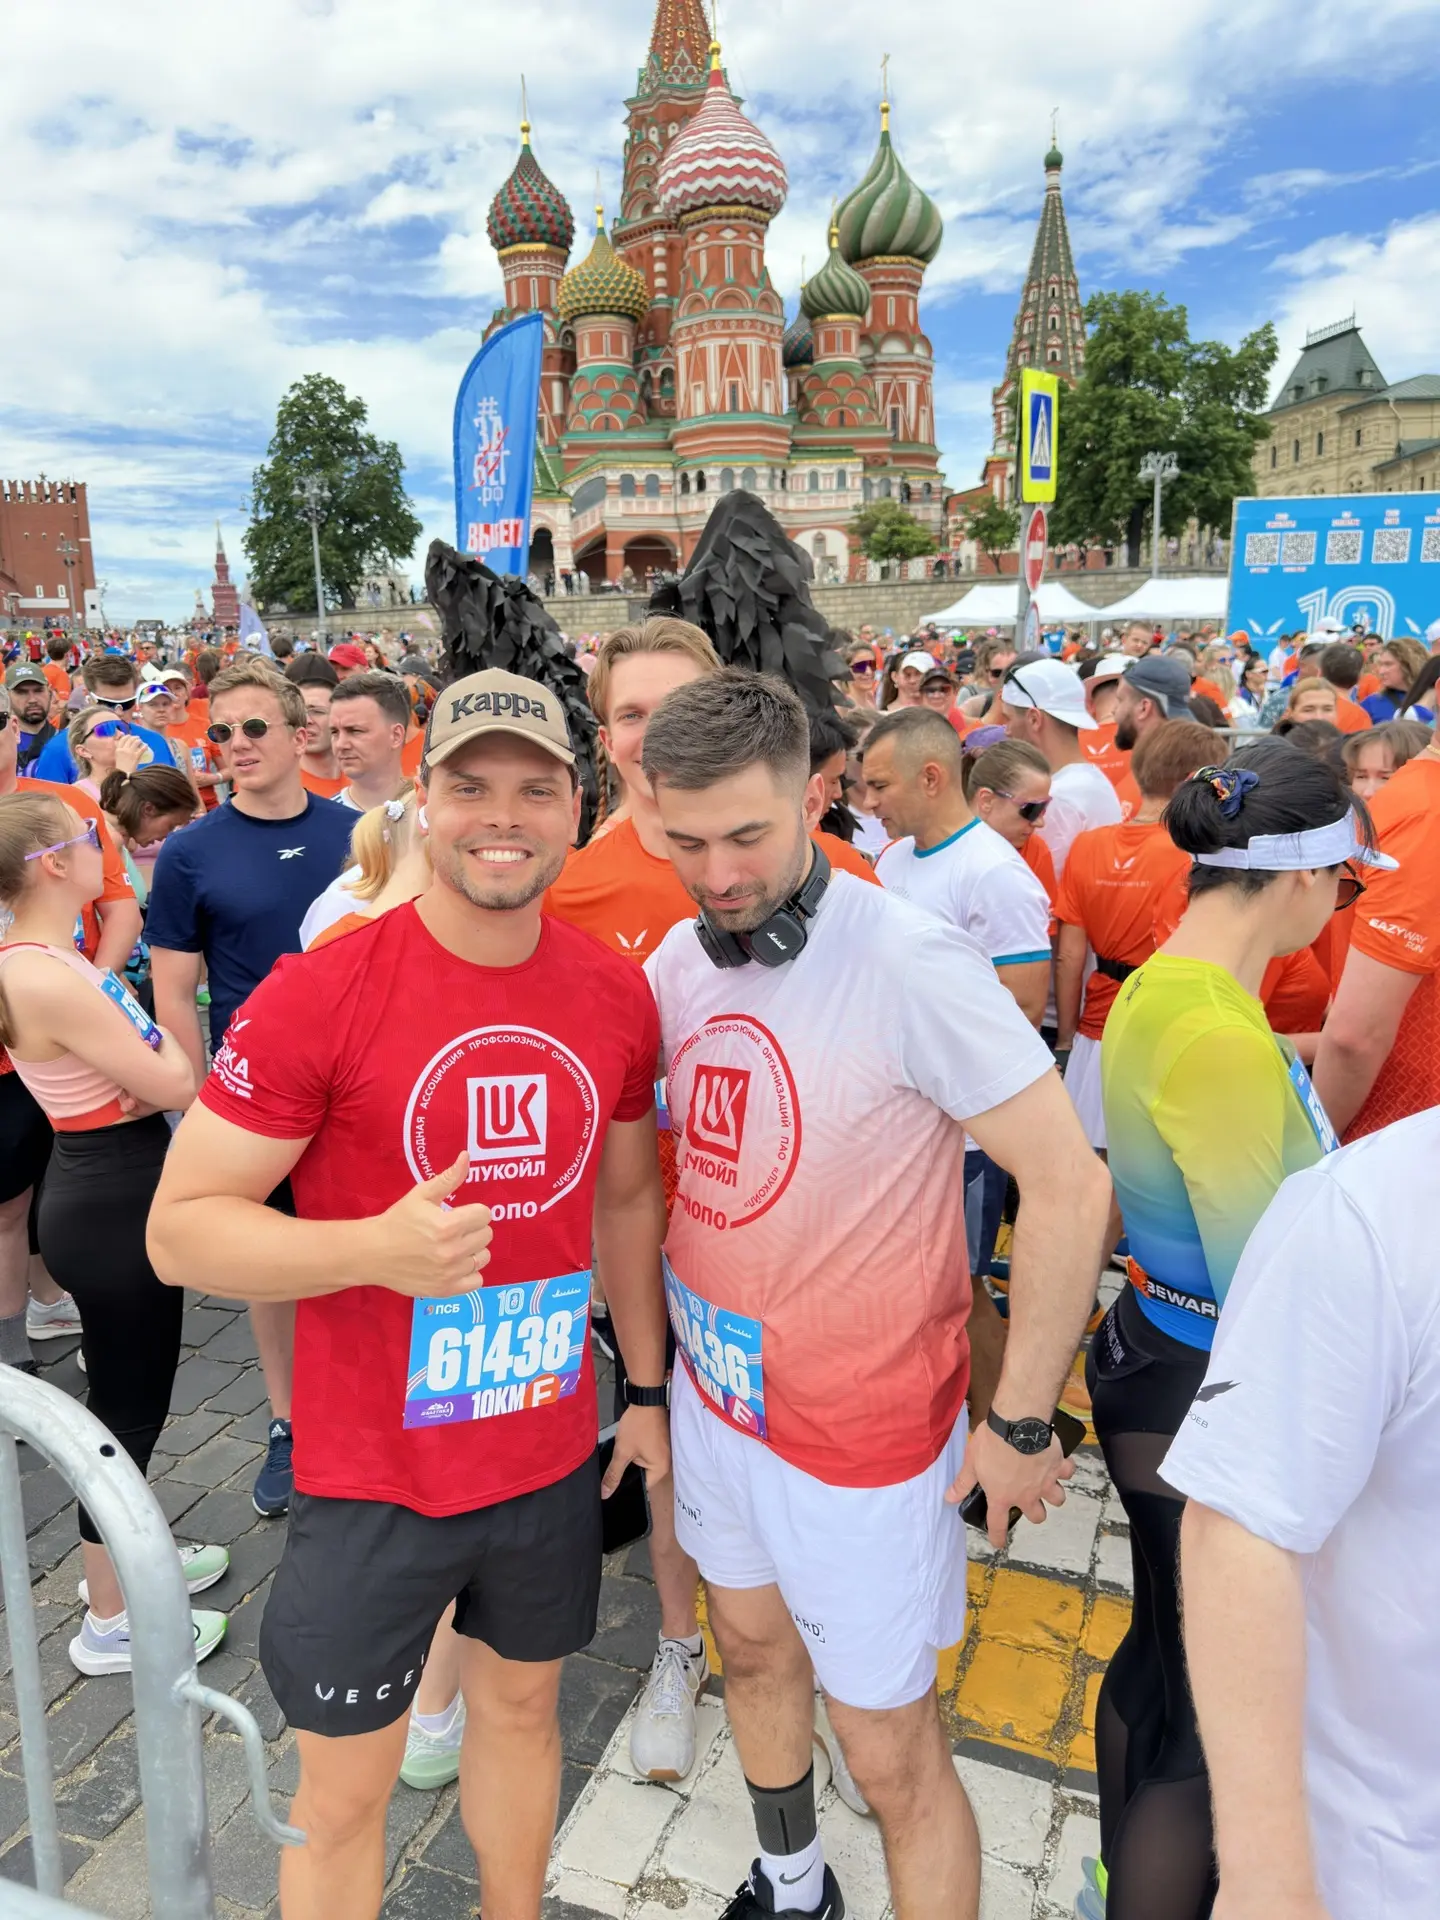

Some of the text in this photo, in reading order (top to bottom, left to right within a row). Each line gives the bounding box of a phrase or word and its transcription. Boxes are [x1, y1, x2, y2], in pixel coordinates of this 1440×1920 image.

[1296, 585, 1396, 643] 10
[451, 692, 548, 723] Kappa
[468, 1035, 547, 1052] ПРОФСОЮЗНЫХ
[420, 1048, 466, 1110] АССОЦИАЦИЯ
[551, 1050, 593, 1111] ОРГАНИЗАЦИЙ
[761, 1047, 792, 1128] ОРГАНИЗАЦИЙ
[778, 1136, 789, 1161] ПАО
[582, 1117, 592, 1139] ПАО
[465, 1158, 546, 1184] ЛУКОЙЛ
[552, 1144, 584, 1190] «ЛУКОЙЛ»
[490, 1201, 538, 1222] ОПО
[435, 1303, 460, 1316] ПСБ
[1147, 1280, 1221, 1318] BEWAR
[426, 1310, 573, 1392] 61438
[533, 1377, 555, 1407] F
[789, 1610, 820, 1637] ARD
[315, 1651, 424, 1704] VECE
